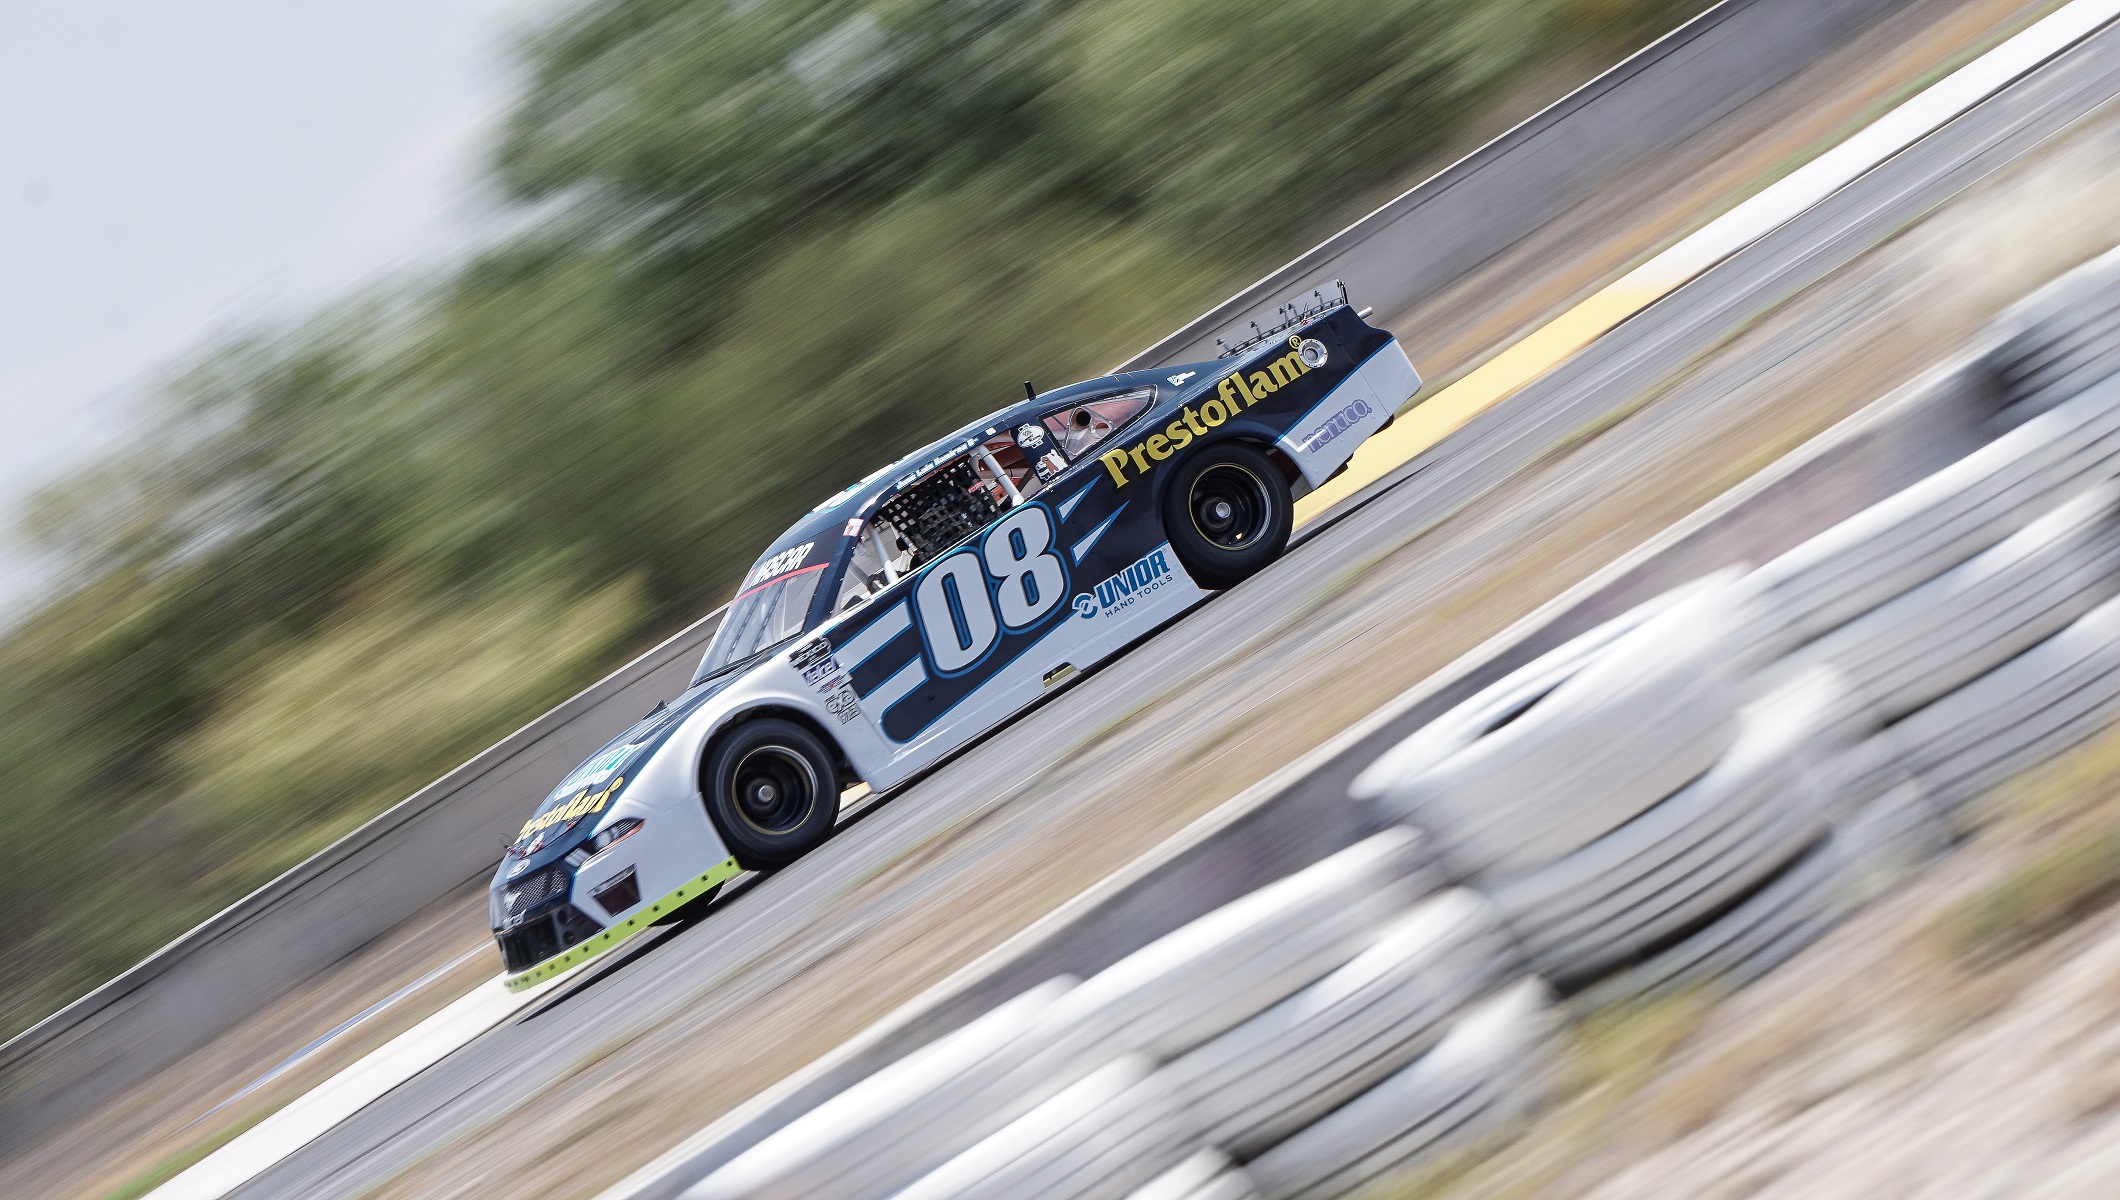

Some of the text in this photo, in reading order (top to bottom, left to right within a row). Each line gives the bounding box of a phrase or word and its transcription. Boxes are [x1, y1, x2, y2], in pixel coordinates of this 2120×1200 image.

[1099, 351, 1314, 489] Prestoflam
[748, 542, 814, 589] NASCAR
[914, 505, 1067, 674] 08
[1096, 550, 1170, 609] UNIOR
[1105, 574, 1173, 618] HAND TOOLS
